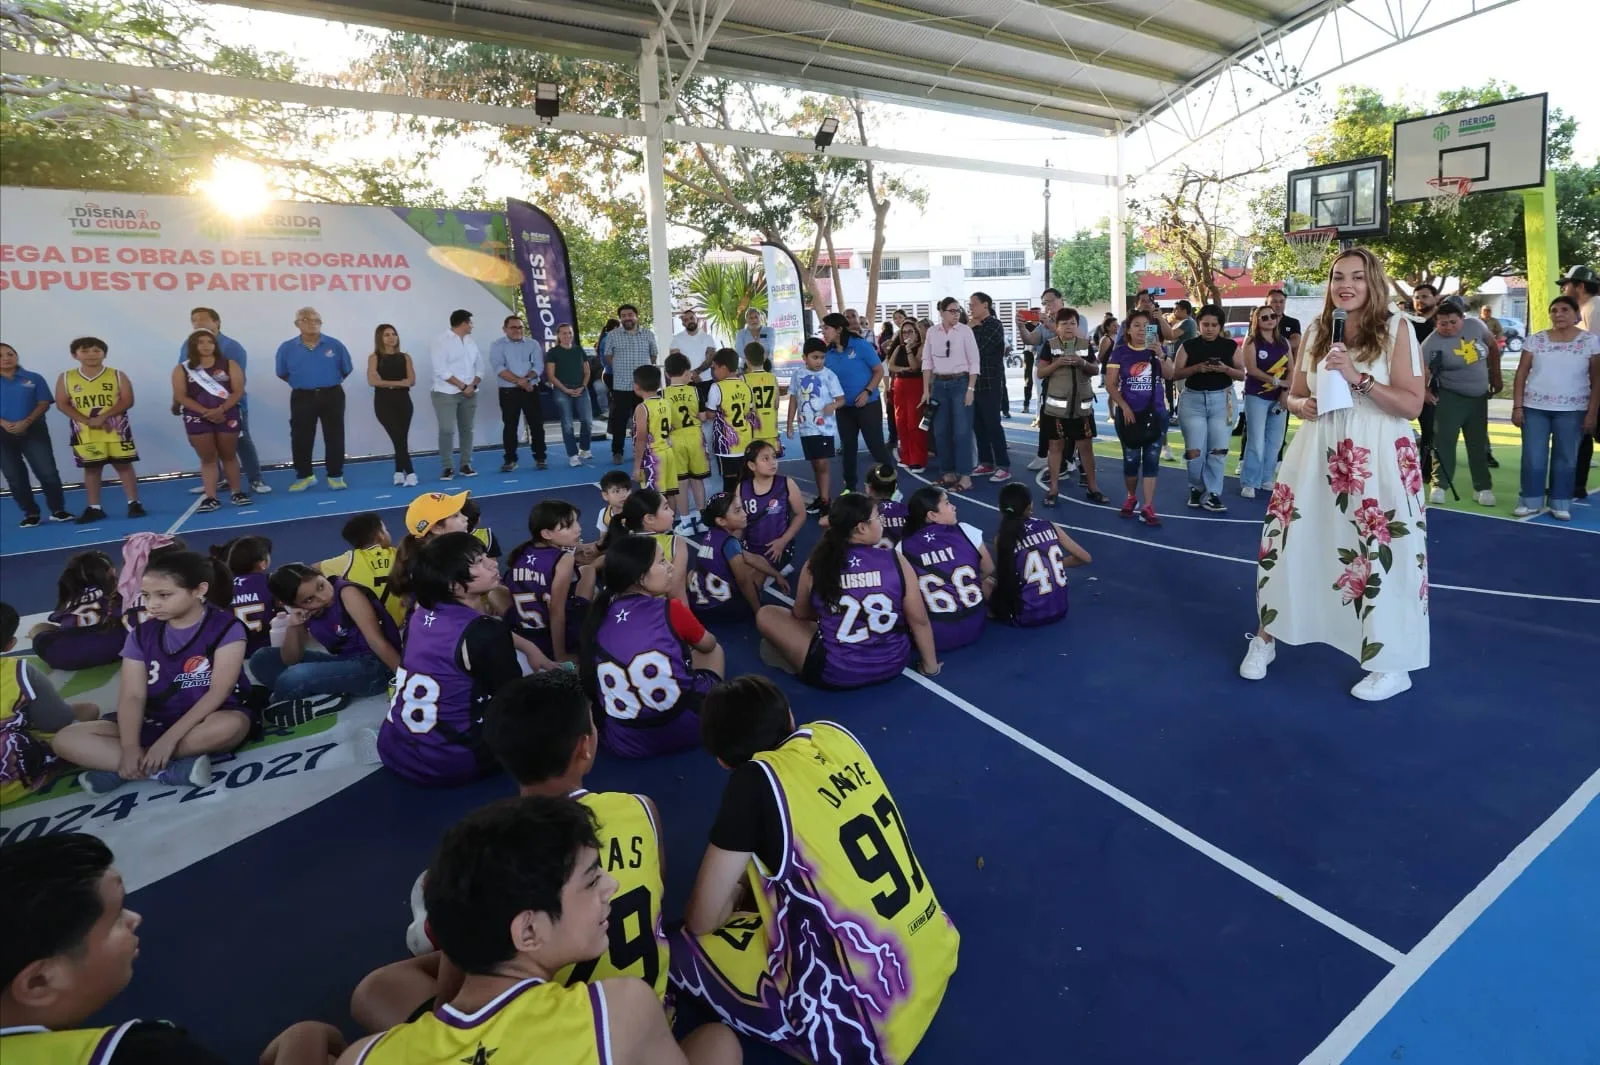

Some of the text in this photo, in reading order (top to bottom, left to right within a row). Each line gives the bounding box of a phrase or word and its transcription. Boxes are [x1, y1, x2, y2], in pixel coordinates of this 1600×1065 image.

[68, 218, 161, 230] TU CIUDAD
[75, 206, 136, 219] DISEÑA
[71, 246, 111, 264] DE
[116, 247, 216, 265] OBRAS
[220, 250, 267, 266] DEL
[272, 251, 410, 269] PROGRAMA
[185, 272, 412, 292] PARTICIPATIVO
[529, 253, 558, 353] EPORTES
[102, 383, 113, 391] 53
[752, 386, 775, 409] 37
[75, 394, 113, 409] RAYOS
[678, 405, 695, 428] 2
[121, 441, 136, 451] 53
[1014, 529, 1058, 553] ALENTINA
[370, 558, 390, 570] LEO
[921, 546, 955, 567] MARY
[840, 571, 882, 590] LISSON
[1024, 544, 1067, 595] 46
[919, 565, 983, 613] 66
[836, 593, 898, 643] 28
[597, 650, 681, 720] 88
[0, 742, 340, 848] 024-2027
[839, 793, 924, 920] 97
